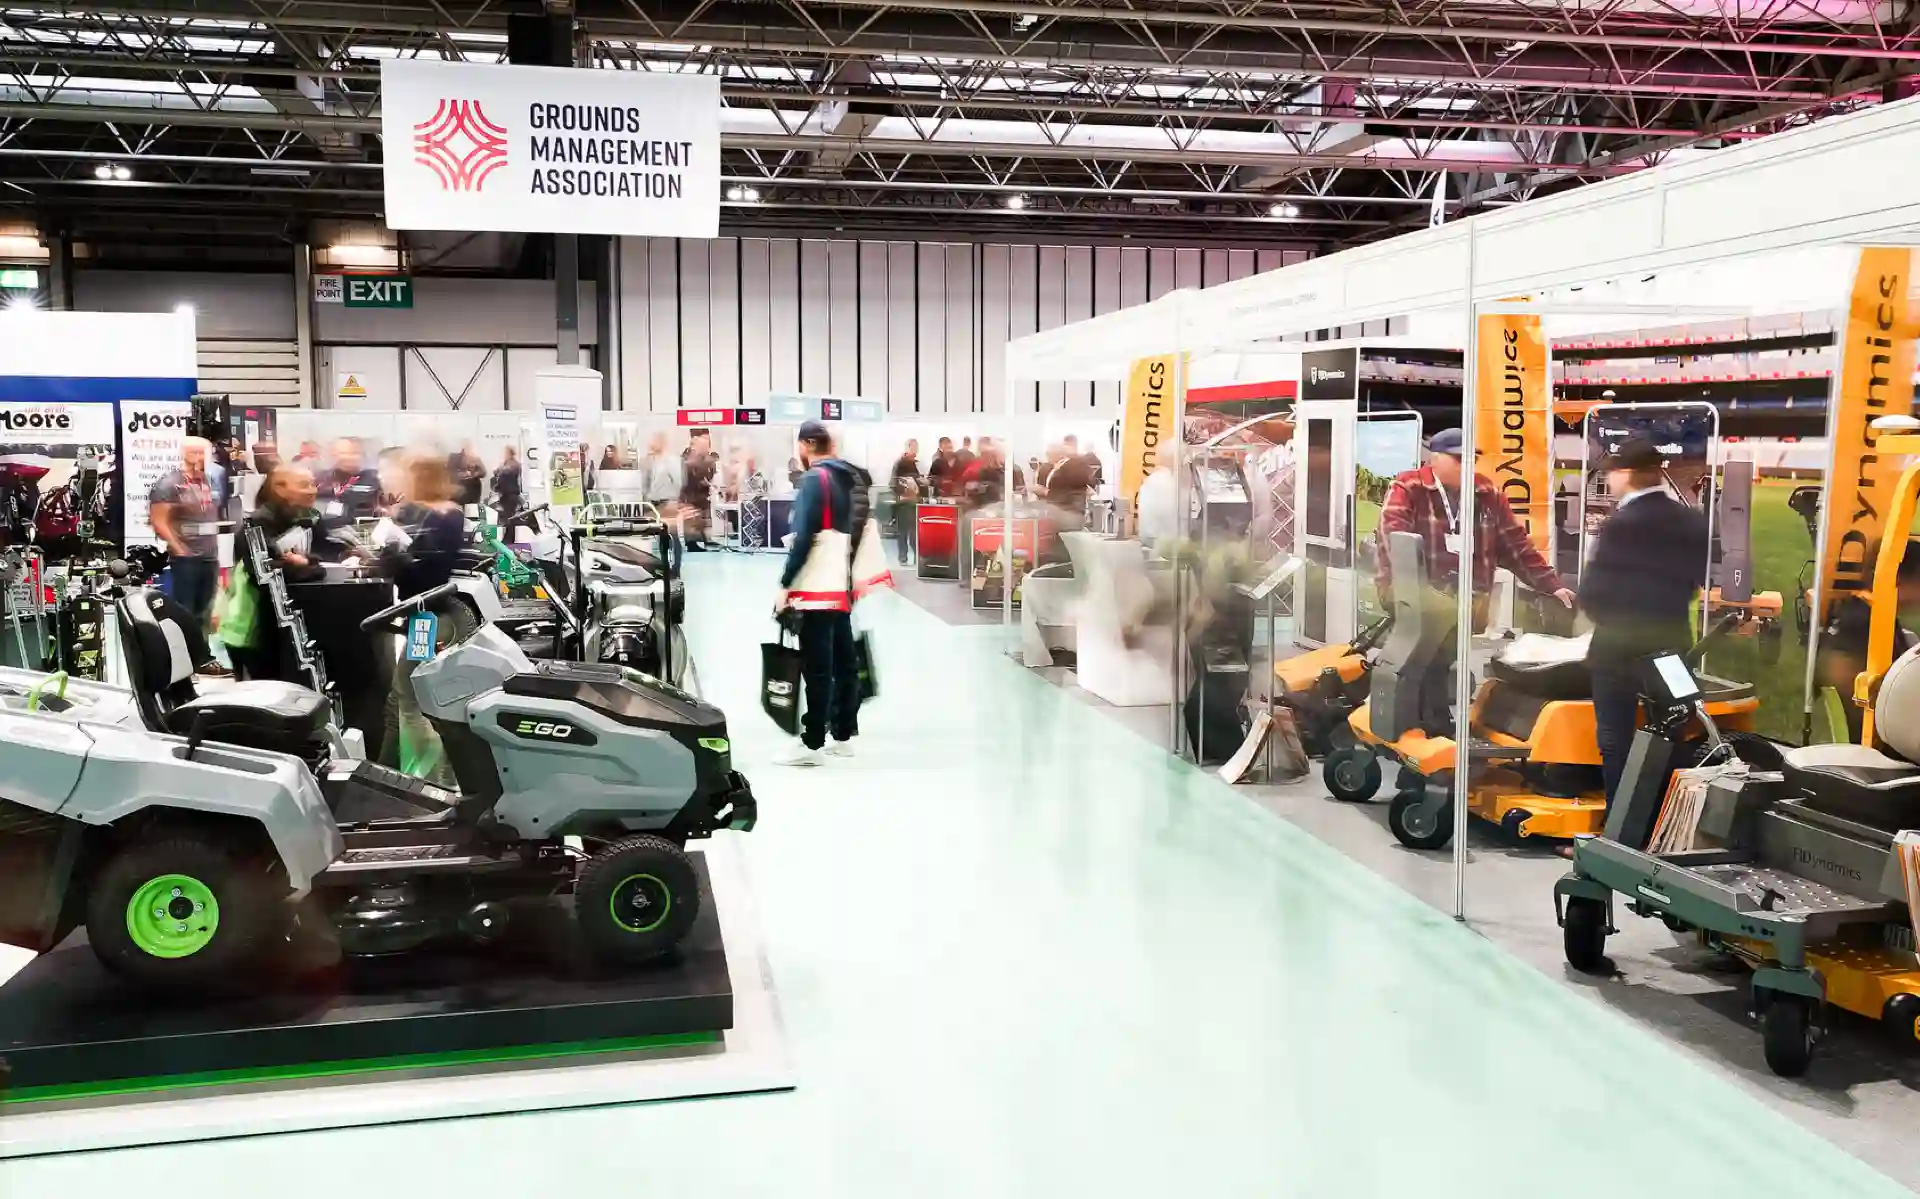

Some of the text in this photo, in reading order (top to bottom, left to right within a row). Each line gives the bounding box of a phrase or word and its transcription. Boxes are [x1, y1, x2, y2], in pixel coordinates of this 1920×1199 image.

[529, 102, 640, 133] GROUNDS
[530, 136, 692, 167] MANAGEMENT
[531, 168, 682, 199] ASSOCIATION
[317, 289, 341, 298] POINT
[319, 279, 337, 288] FIRE
[350, 280, 407, 302] EXIT
[132, 439, 178, 449] ATTENT
[516, 720, 572, 738] EGO
